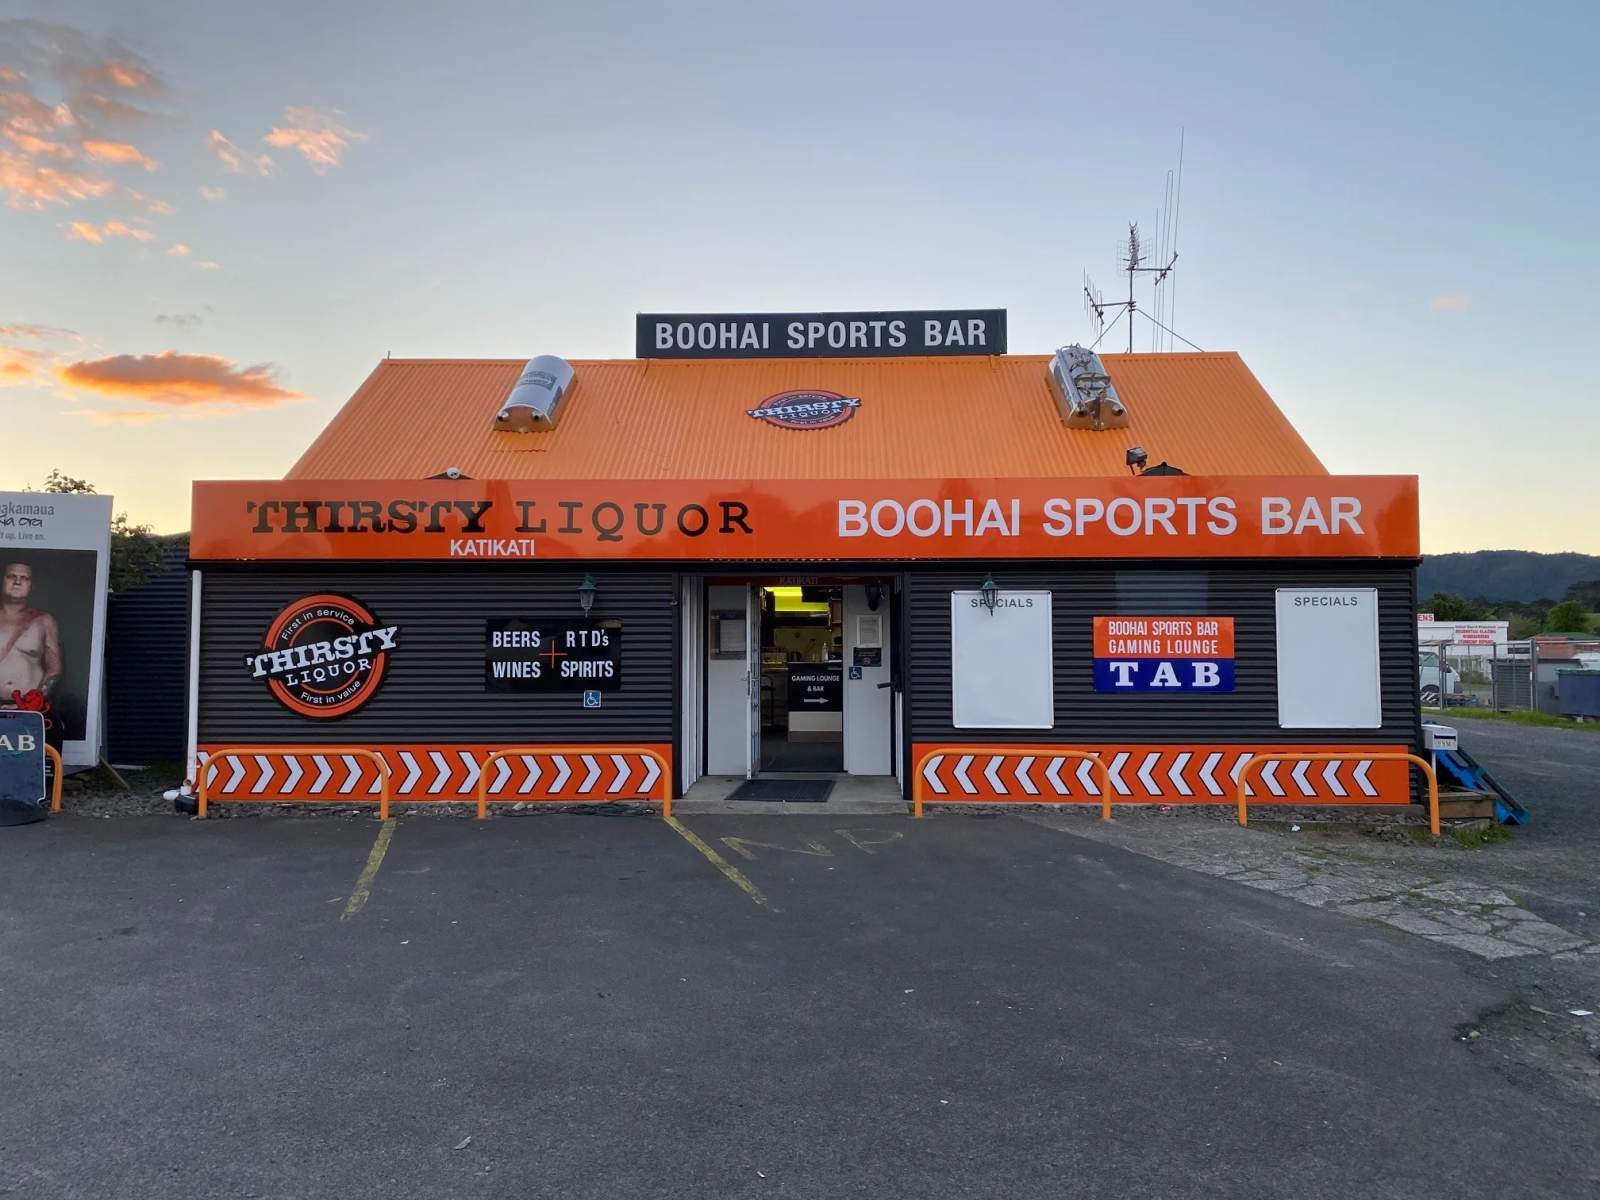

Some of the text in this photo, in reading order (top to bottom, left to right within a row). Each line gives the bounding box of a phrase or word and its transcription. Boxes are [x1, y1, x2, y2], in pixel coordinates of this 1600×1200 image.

[655, 319, 987, 350] BOOHAI SPORTS BAR
[748, 398, 860, 418] THIRSTY
[0, 501, 55, 516] akamaua
[838, 496, 1365, 537] BOOHAI SPORTS BAR
[246, 500, 753, 542] THIRSTY LIQUOR
[450, 539, 535, 556] KATIKATI
[970, 598, 1033, 608] SPCIALS
[1294, 596, 1358, 606] SPECIALS
[281, 609, 355, 640] First in service
[1108, 621, 1218, 636] BOOHAI SPORTS BAR
[492, 631, 541, 648] BEERS
[1108, 639, 1219, 654] GAMING LOUNGE
[246, 626, 398, 678] THIRSTY
[285, 658, 372, 687] LIQUOR
[492, 661, 541, 678] WINES
[560, 660, 614, 677] SPIRITS
[1109, 661, 1221, 687] TAB
[300, 680, 361, 704] First in value
